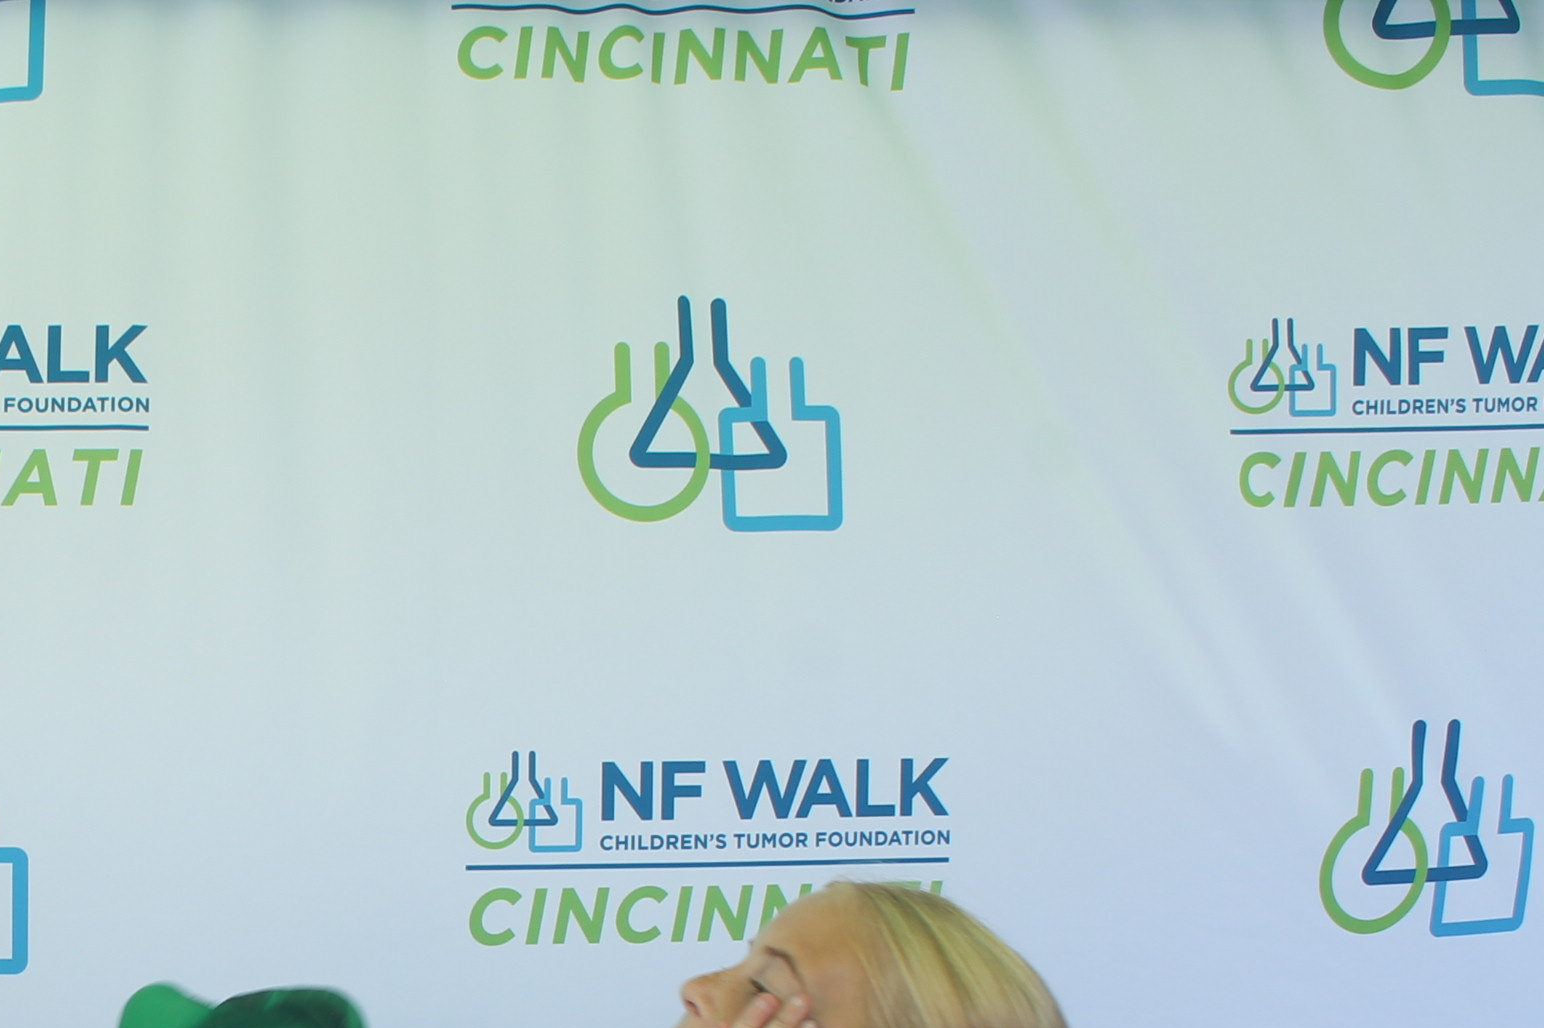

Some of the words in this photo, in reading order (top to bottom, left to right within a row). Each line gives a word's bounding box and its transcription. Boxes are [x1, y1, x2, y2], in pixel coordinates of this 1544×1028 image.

[456, 24, 911, 91] CINCINNATI
[1353, 326, 1449, 387] NF
[3, 396, 151, 414] FOUNDATION
[1351, 397, 1467, 415] CHILDREN'S
[1472, 396, 1538, 413] TUMOR
[1239, 446, 1544, 508] CINCINN
[600, 760, 707, 821] NF
[722, 757, 950, 820] WALK
[599, 833, 727, 851] CHILDREN'S
[734, 832, 809, 850] TUMOR
[815, 829, 951, 848] FOUNDATION
